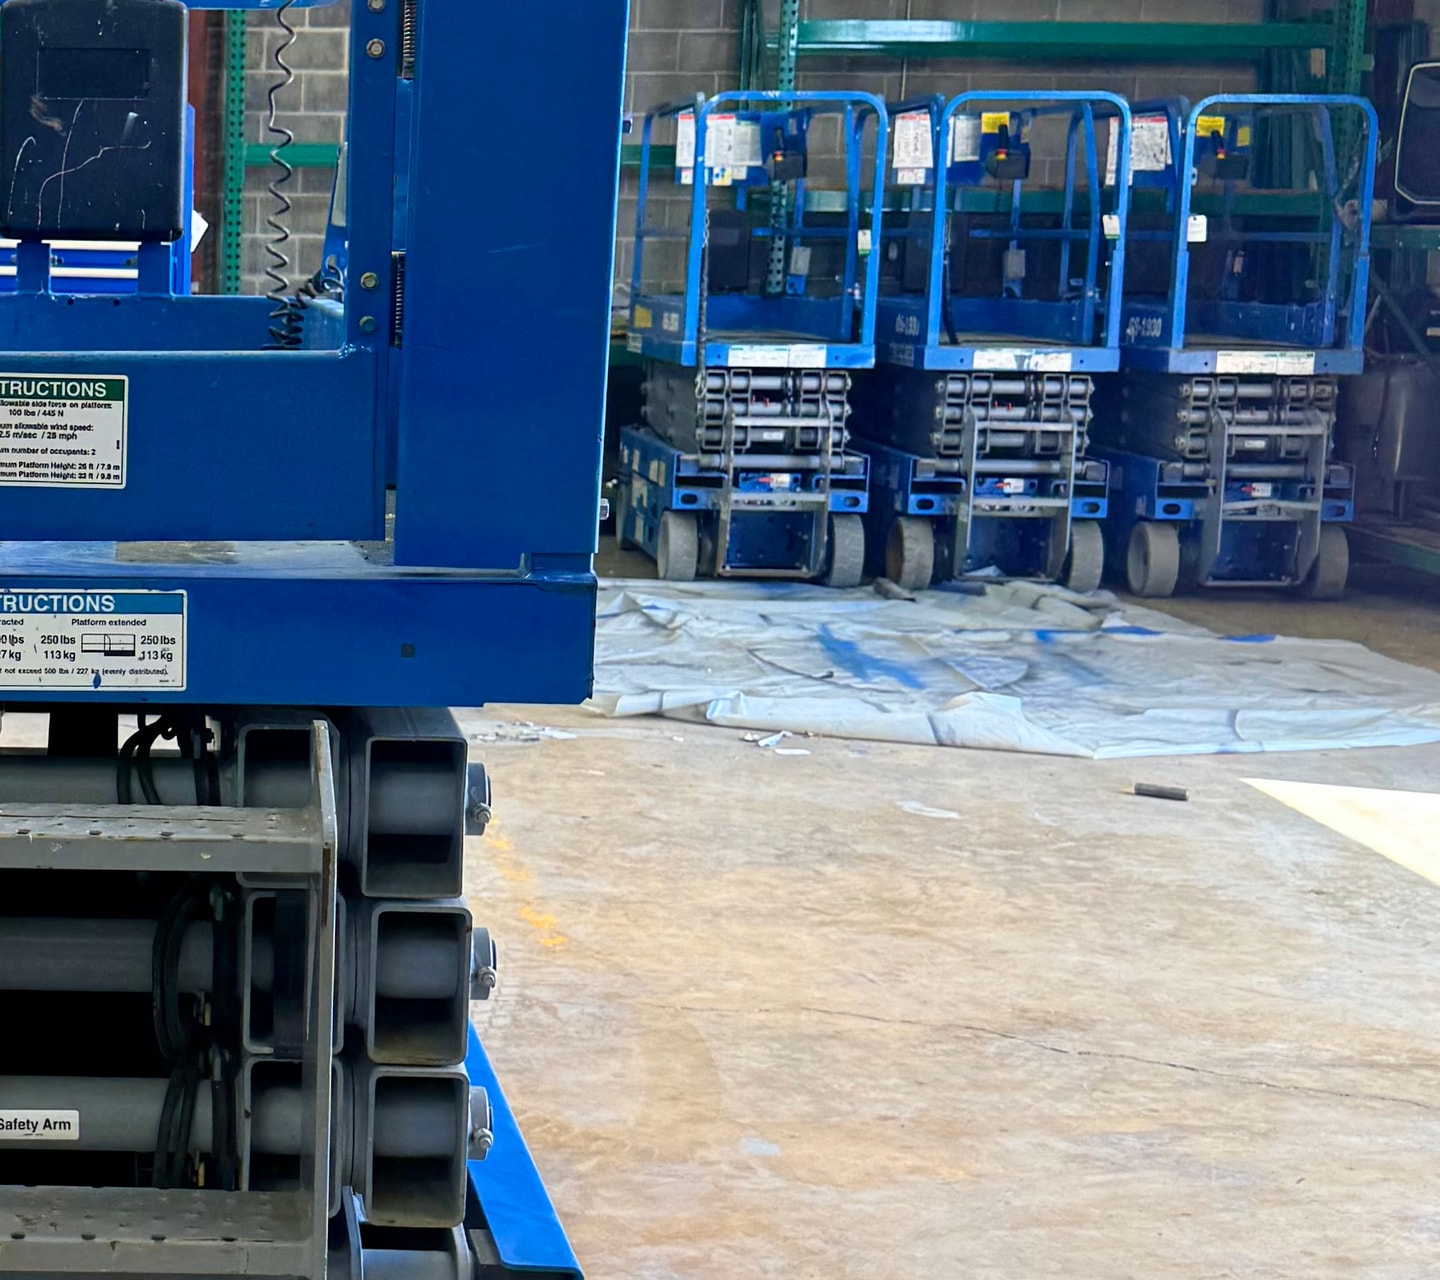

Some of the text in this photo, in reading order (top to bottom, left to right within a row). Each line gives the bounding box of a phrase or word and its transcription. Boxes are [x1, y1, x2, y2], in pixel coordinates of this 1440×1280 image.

[14, 422, 48, 430] allowable
[69, 424, 94, 432] speed:
[12, 431, 37, 439] m/sec
[59, 433, 77, 441] mph
[71, 618, 147, 626] Platform extended
[9, 635, 24, 644] lbs
[40, 635, 76, 644] 250 lbs
[140, 635, 176, 645] 250 lbs
[9, 650, 22, 661] kg
[44, 650, 76, 662] 113 kg
[141, 650, 173, 662] 113 kg
[43, 1118, 71, 1130] Arm
